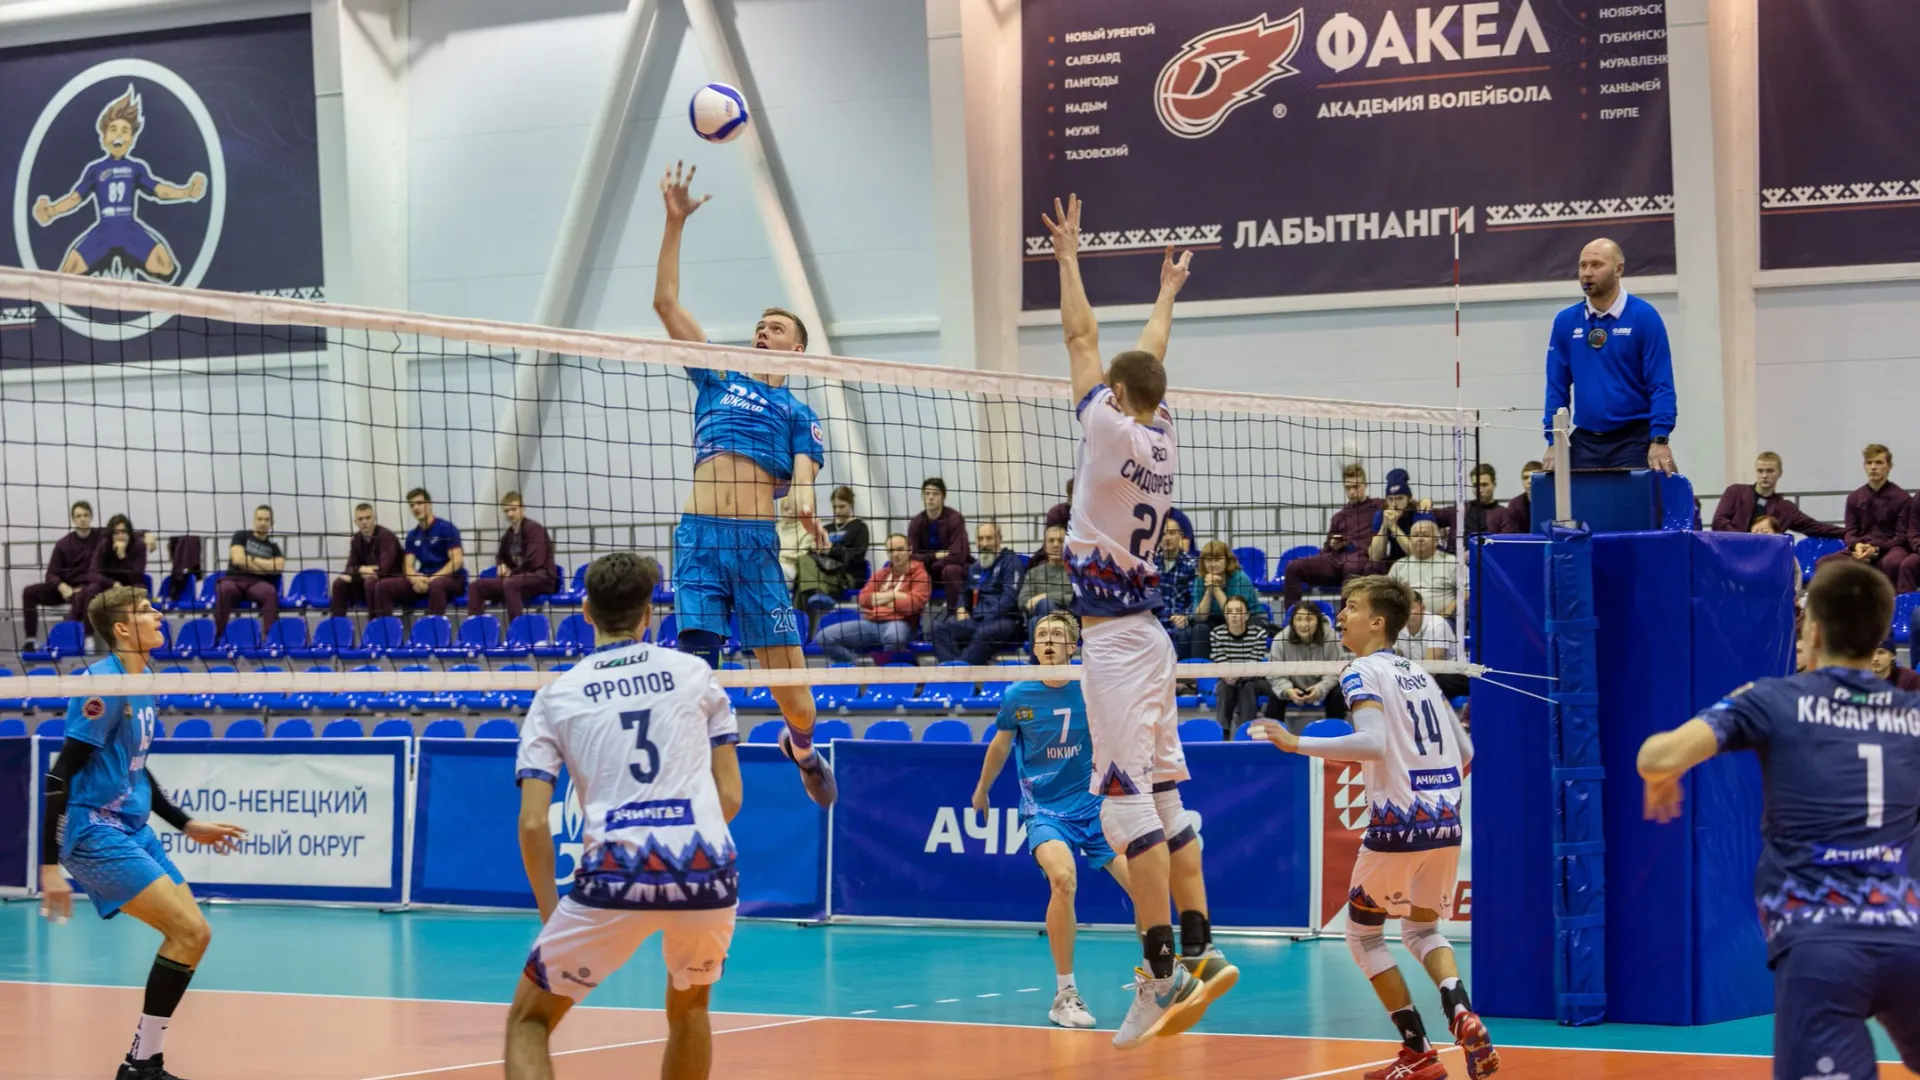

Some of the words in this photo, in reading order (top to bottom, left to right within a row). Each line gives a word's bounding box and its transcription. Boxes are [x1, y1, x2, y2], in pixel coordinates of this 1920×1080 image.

[1599, 4, 1663, 19] НОЯБРЬСК
[1065, 28, 1106, 43] НОВЫЙ
[1107, 23, 1156, 39] УРЕНГОЙ
[1316, 0, 1551, 73] ФАКЕЛ
[1065, 52, 1122, 66] САЛЕХАРД
[1065, 75, 1119, 89] ПАНГОДЫ
[1600, 78, 1661, 94] ХАНЫМЕЙ
[1065, 101, 1107, 114] НАДЫМ
[1317, 95, 1425, 119] АКАДЕМИЯ
[1428, 85, 1552, 109] ВОЛЕЙБОЛА
[1600, 107, 1640, 119] ПУРПЕ
[1065, 125, 1100, 137] МУЖИ
[1065, 144, 1129, 160] ТАЗОВСКИЙ
[108, 181, 126, 203] 89
[1233, 205, 1475, 249] ЛАБЫТНАНГИ
[583, 671, 676, 703] ФРОЛОВ
[1053, 708, 1071, 744] 7
[1406, 698, 1443, 756] 14
[619, 708, 660, 784] 3
[1857, 743, 1885, 828] 1
[299, 834, 365, 857] ОКРУГ
